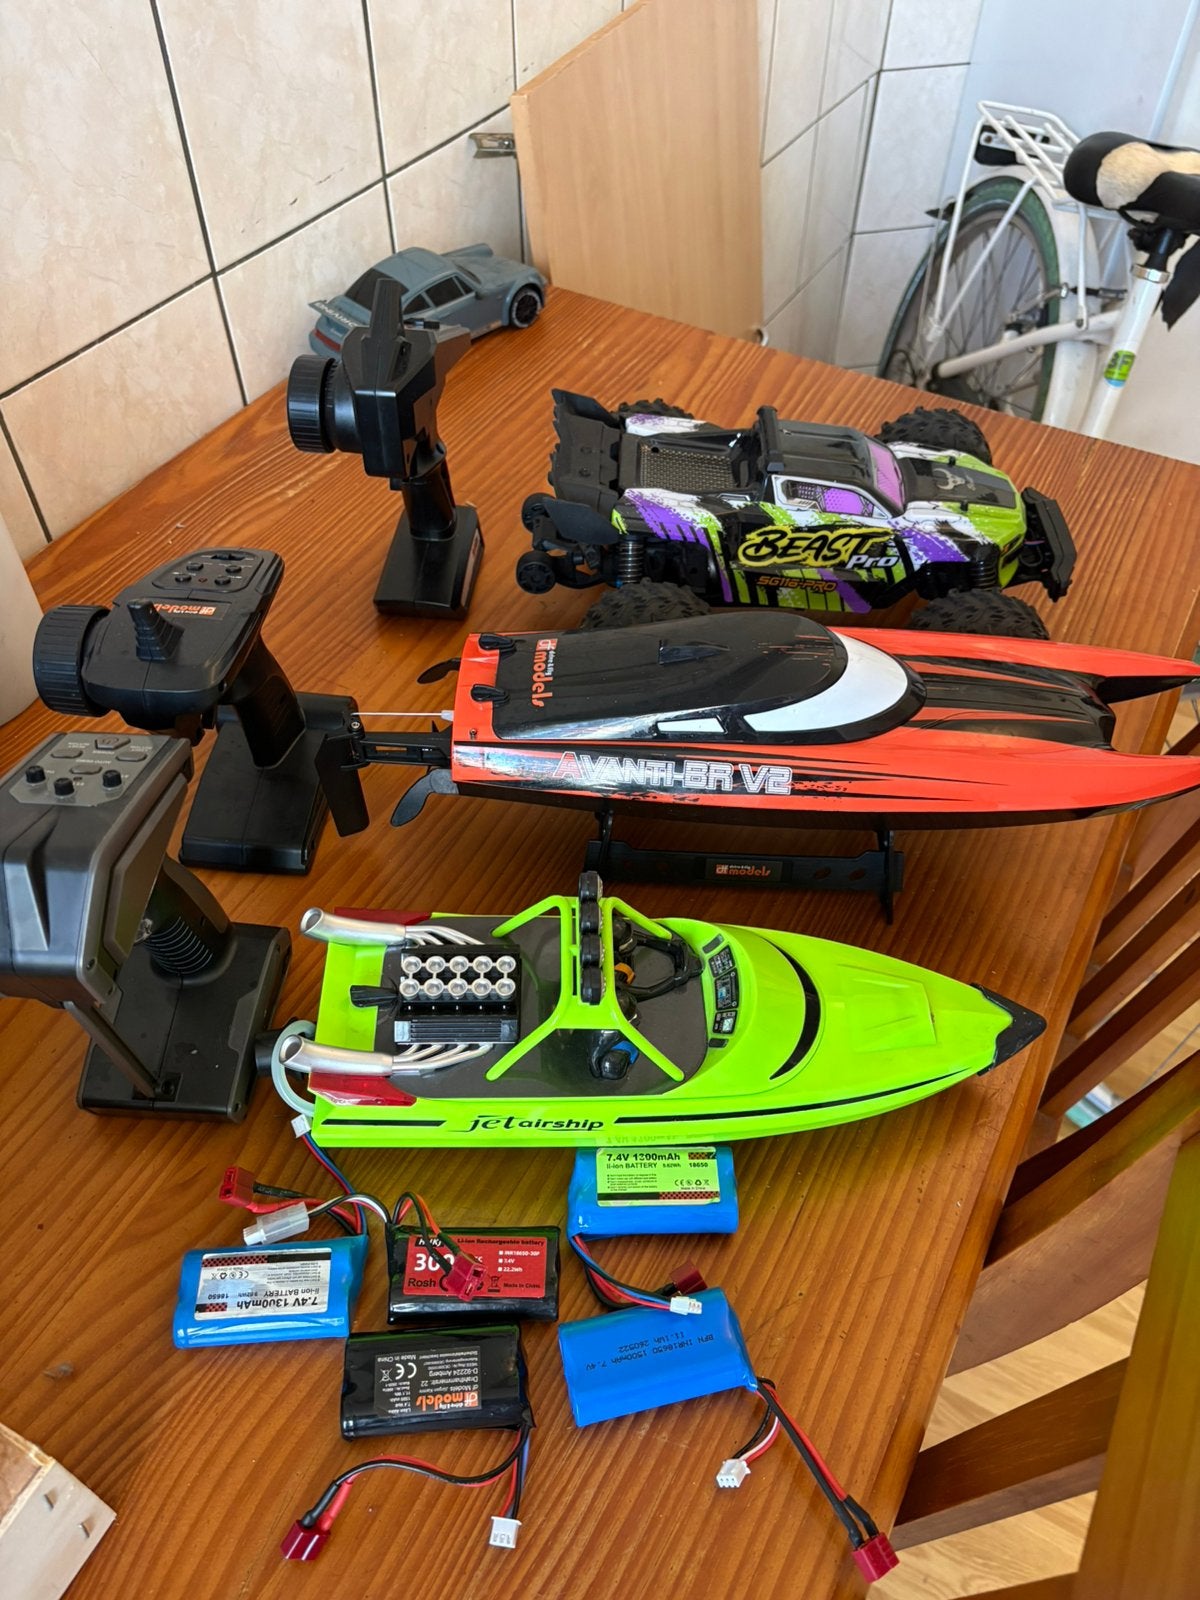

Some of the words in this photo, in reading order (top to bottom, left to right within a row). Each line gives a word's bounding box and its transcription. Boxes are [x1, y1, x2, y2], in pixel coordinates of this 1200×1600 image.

[741, 528, 891, 564] BEAST
[846, 555, 899, 569] Pro
[757, 576, 838, 592] SG116-PRO
[532, 651, 553, 707] models
[741, 764, 793, 795] V2
[728, 866, 771, 877] models
[606, 1153, 629, 1162] 7.4V
[633, 1152, 681, 1161] 1300mAh
[408, 1277, 436, 1287] Rosh
[208, 1292, 229, 1300] 18650
[263, 1288, 299, 1298] BATTERY
[237, 1298, 289, 1310] 1300mAh
[293, 1296, 318, 1306] 7.4V
[696, 1333, 714, 1343] BFN
[611, 1349, 648, 1364] 1500mAh
[586, 1360, 607, 1371] 7.4V
[415, 1393, 463, 1411] models
